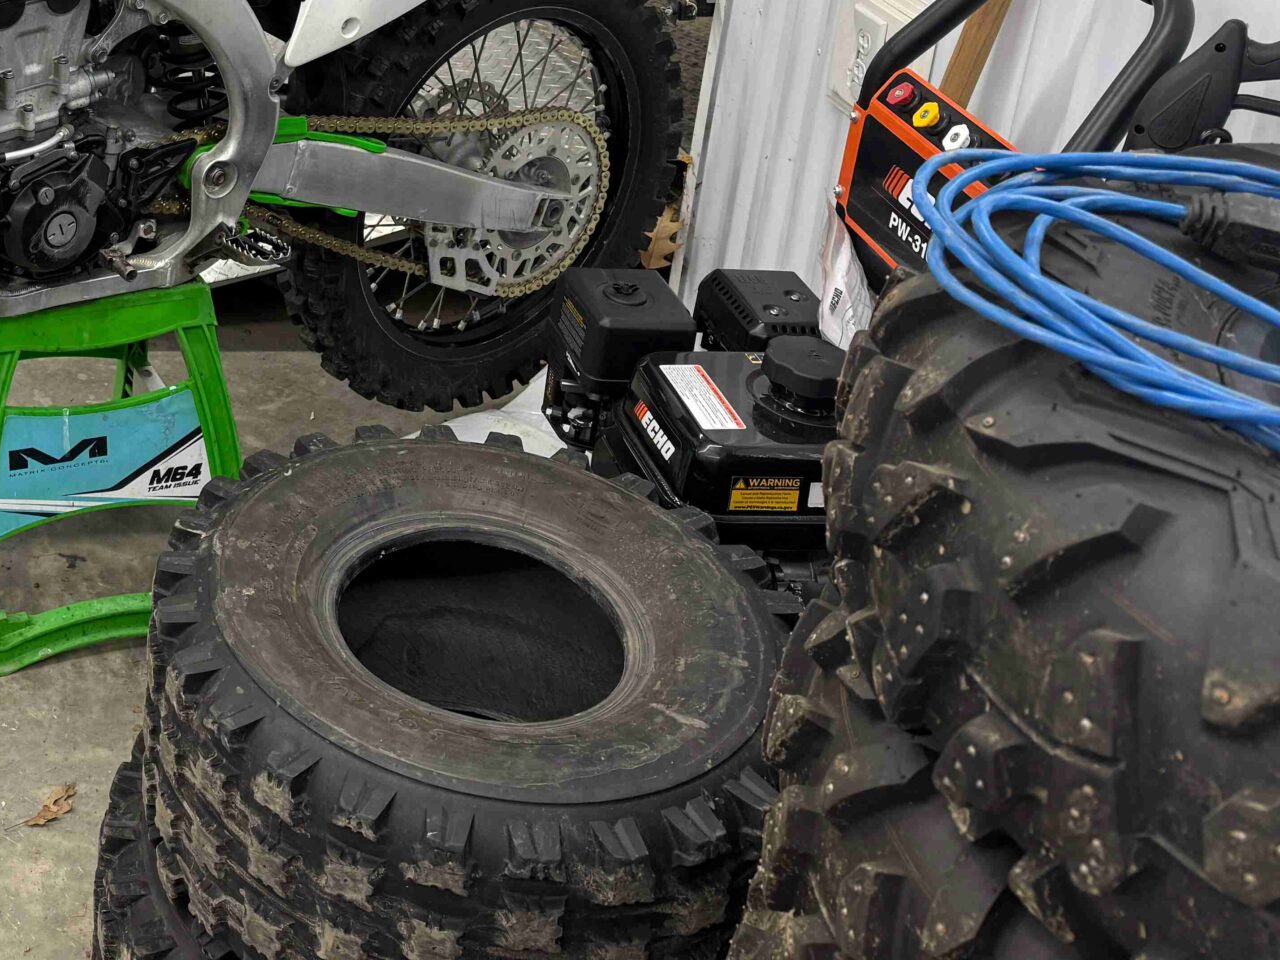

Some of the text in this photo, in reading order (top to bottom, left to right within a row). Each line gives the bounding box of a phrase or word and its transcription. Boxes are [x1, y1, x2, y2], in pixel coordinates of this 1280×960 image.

[888, 212, 929, 263] PW-31
[640, 409, 676, 461] ECHO
[9, 468, 46, 478] MATRIX
[148, 462, 203, 486] M64
[748, 478, 801, 487] WARNING
[147, 479, 202, 493] TEAM ISSUE
